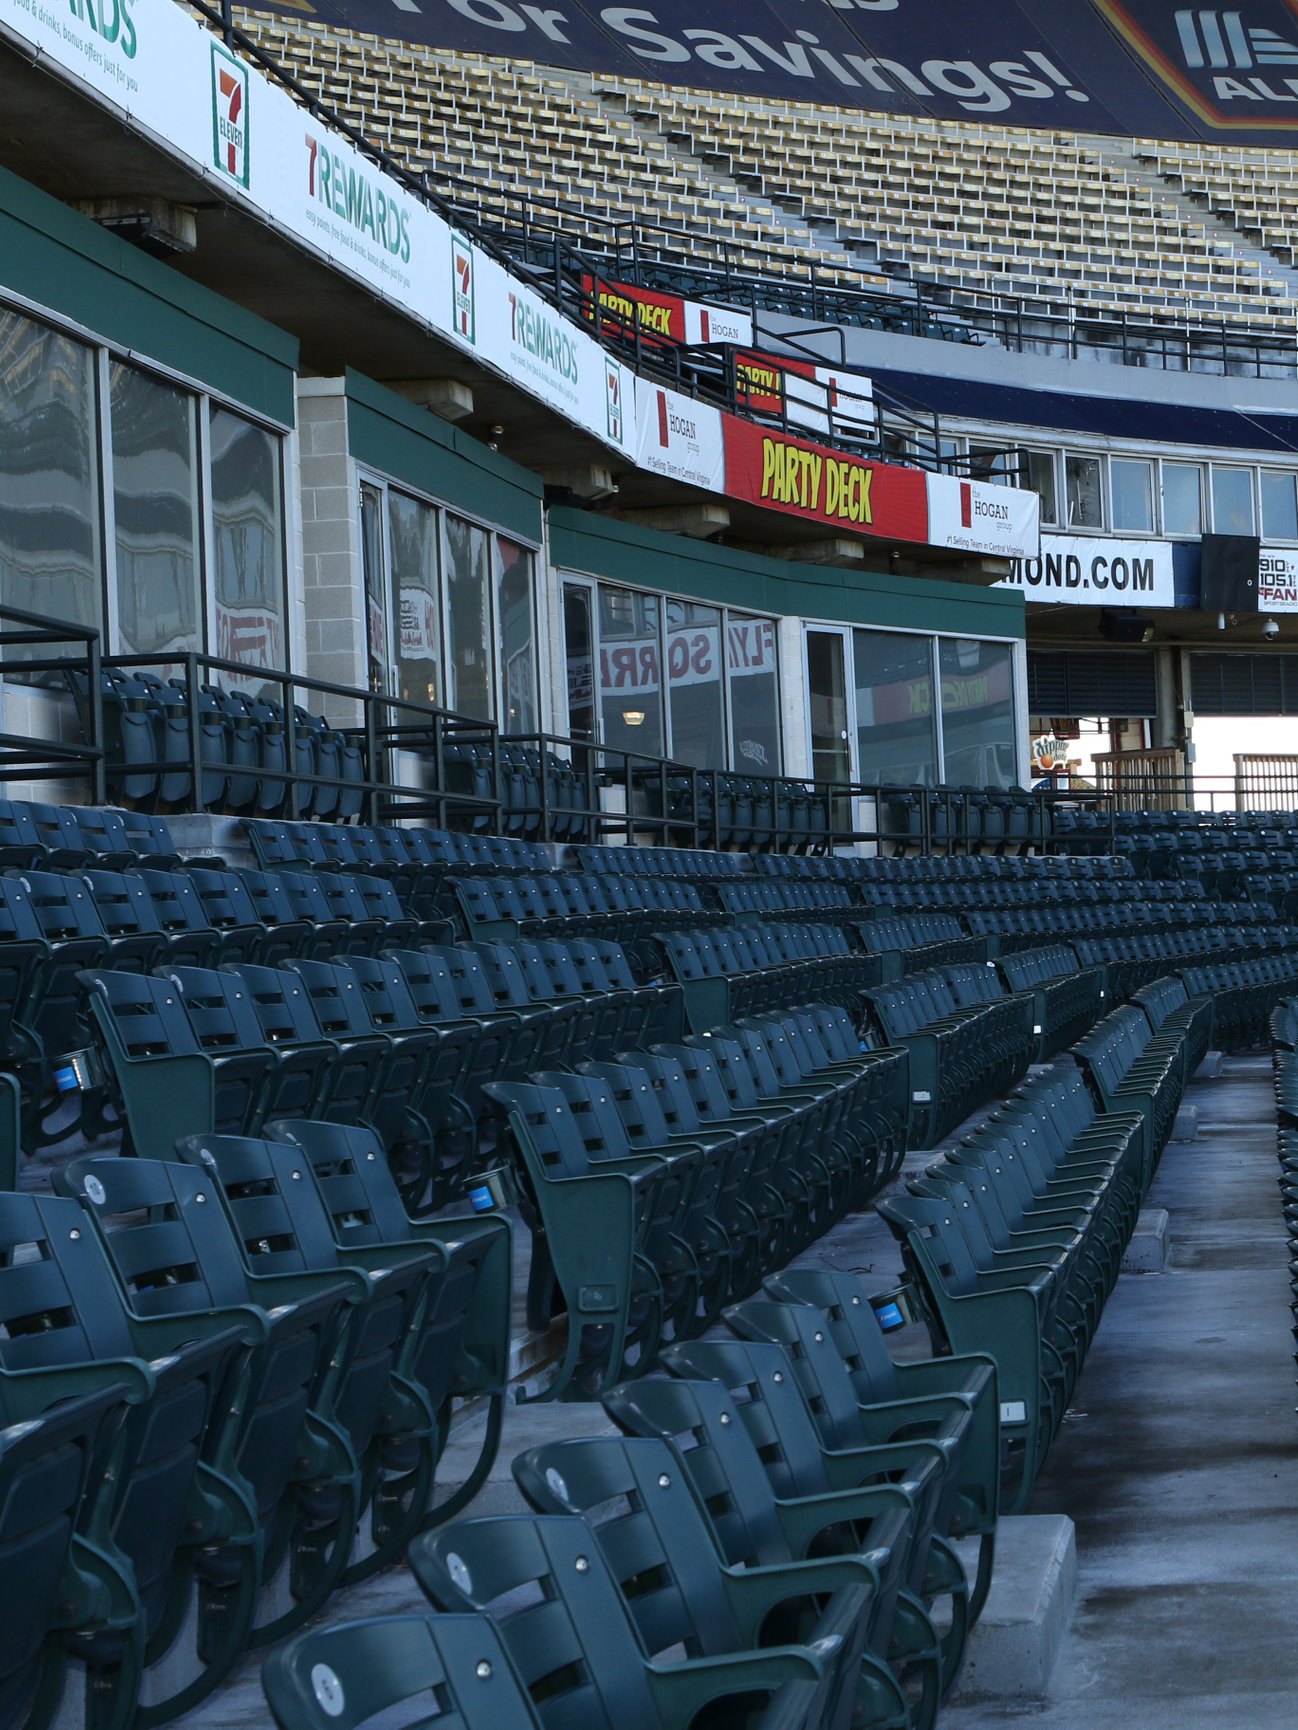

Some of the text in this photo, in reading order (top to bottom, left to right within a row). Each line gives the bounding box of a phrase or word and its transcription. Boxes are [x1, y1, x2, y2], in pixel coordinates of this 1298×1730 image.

[62, 22, 84, 51] bonus
[84, 42, 103, 66] offers
[126, 75, 139, 92] you
[391, 0, 1090, 112] or Savings!
[711, 323, 739, 340] HOGAN
[669, 413, 697, 440] HOGAN
[760, 436, 874, 525] PARTY DECK
[974, 500, 1009, 520] HOGAN
[953, 536, 969, 549] Selling
[970, 539, 983, 549] Team
[989, 542, 1006, 552] Central
[1006, 545, 1025, 556] Virginia
[1260, 559, 1286, 572] 910
[1260, 573, 1292, 587] 105.1
[1264, 588, 1297, 601] FAN
